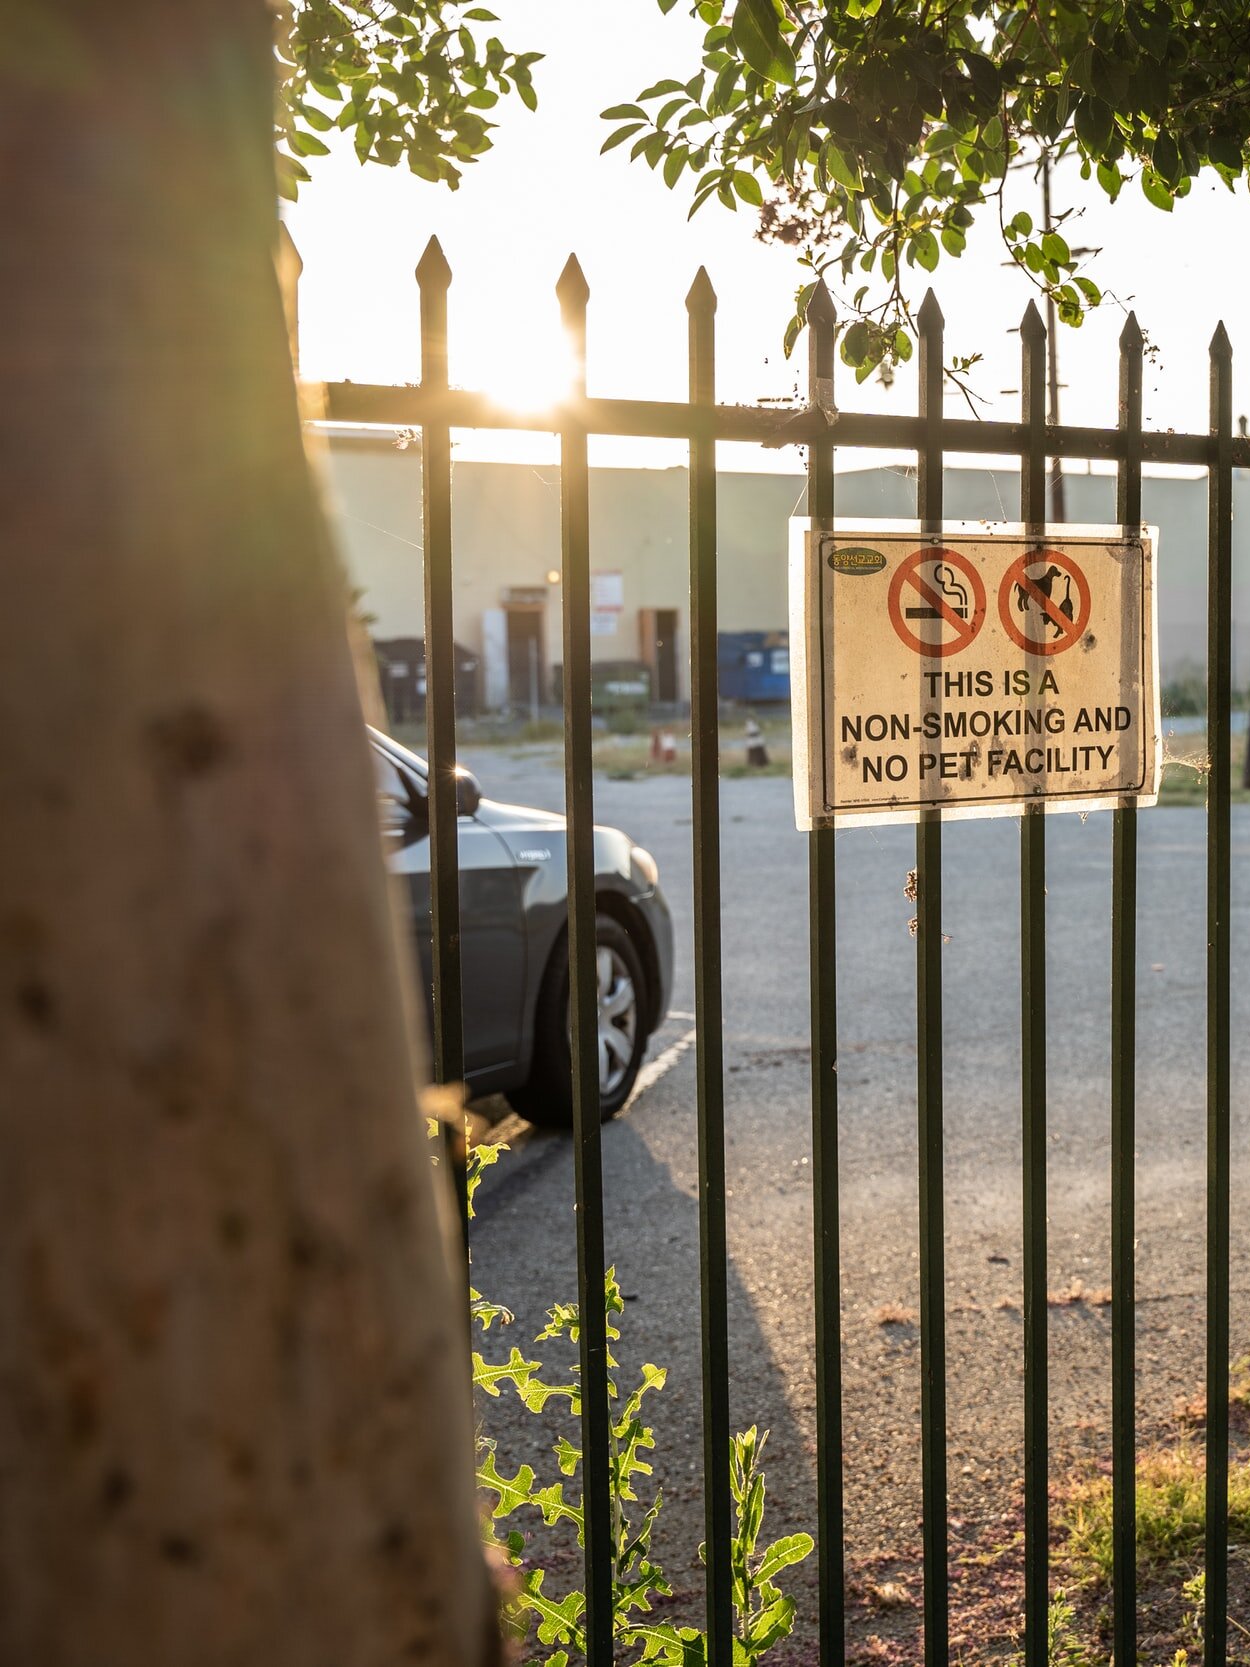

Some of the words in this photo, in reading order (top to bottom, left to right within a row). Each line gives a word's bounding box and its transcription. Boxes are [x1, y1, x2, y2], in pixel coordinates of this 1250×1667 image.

[833, 554, 883, 566] 동양선교교회
[924, 670, 994, 698] THIS
[1004, 670, 1031, 696] IS
[1038, 669, 1060, 695] A
[841, 708, 1065, 742] NON-SMOKING
[1073, 706, 1132, 733] AND
[862, 754, 908, 783] NO
[919, 752, 977, 780] PET
[987, 745, 1115, 776] FACILITY
